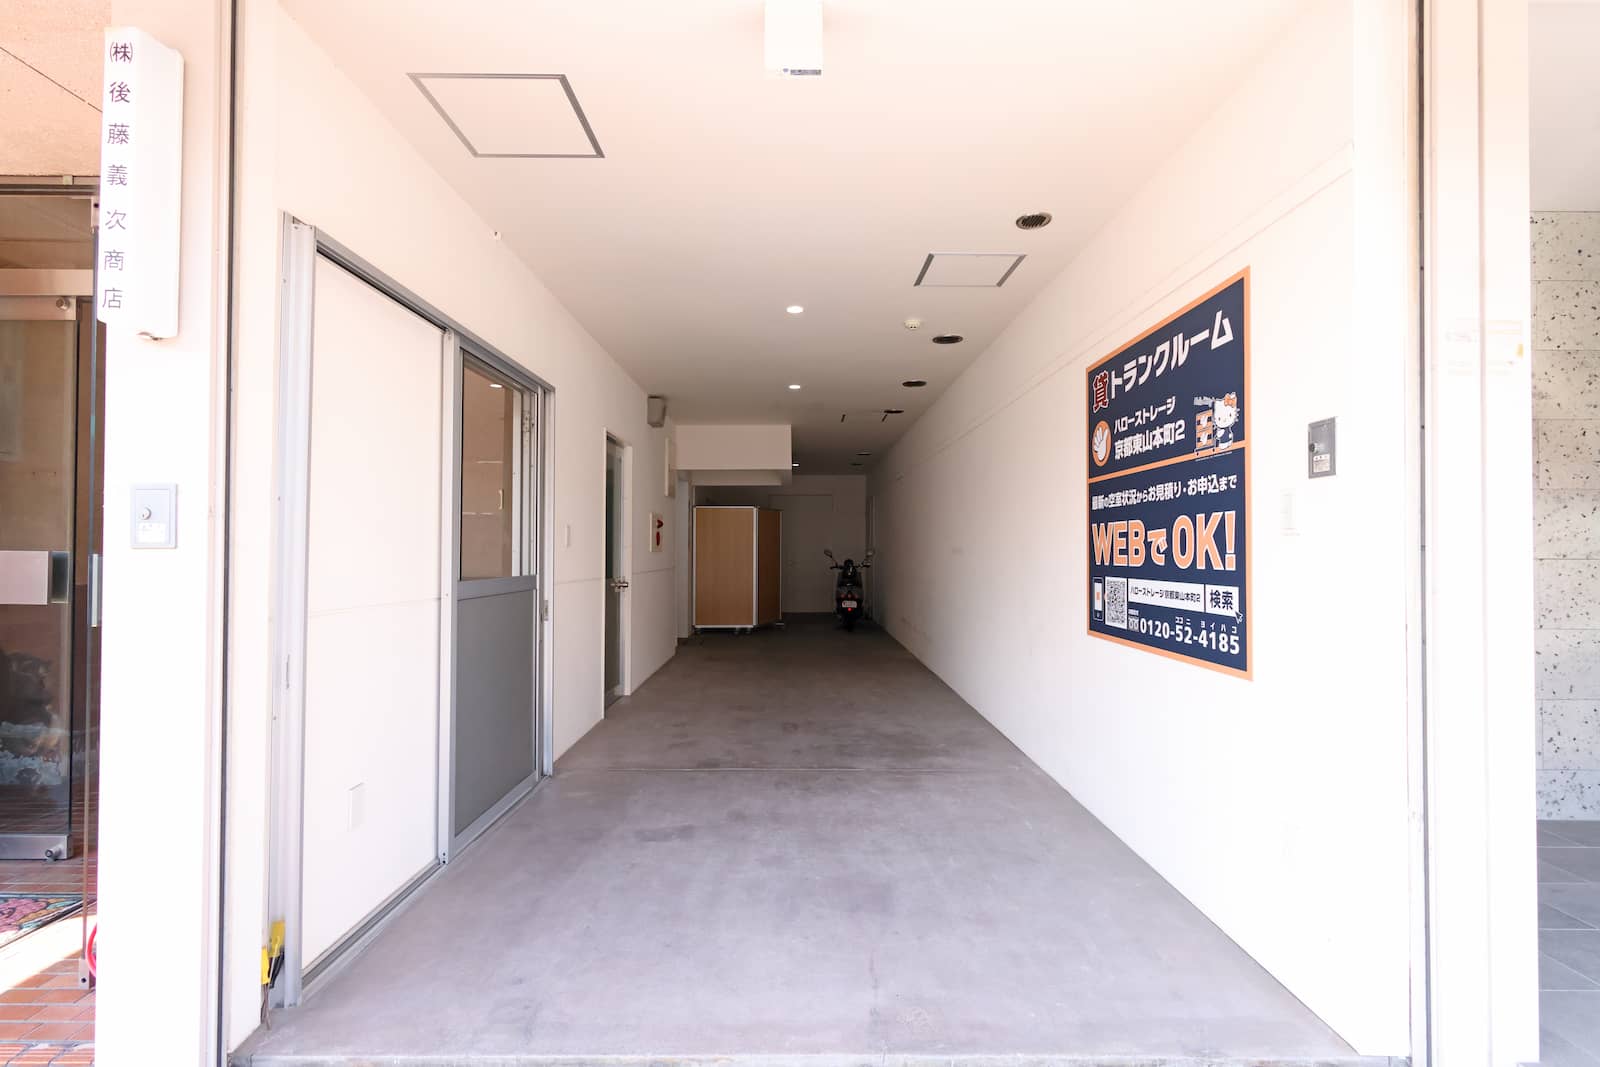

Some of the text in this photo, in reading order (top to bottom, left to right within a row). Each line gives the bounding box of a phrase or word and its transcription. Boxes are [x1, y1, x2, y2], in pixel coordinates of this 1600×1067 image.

[1114, 396, 1176, 434] ハローストレージ
[1114, 419, 1186, 460] 京都東山本町2
[1209, 588, 1234, 611] 検索
[1139, 617, 1240, 655] 0120-52-4185
